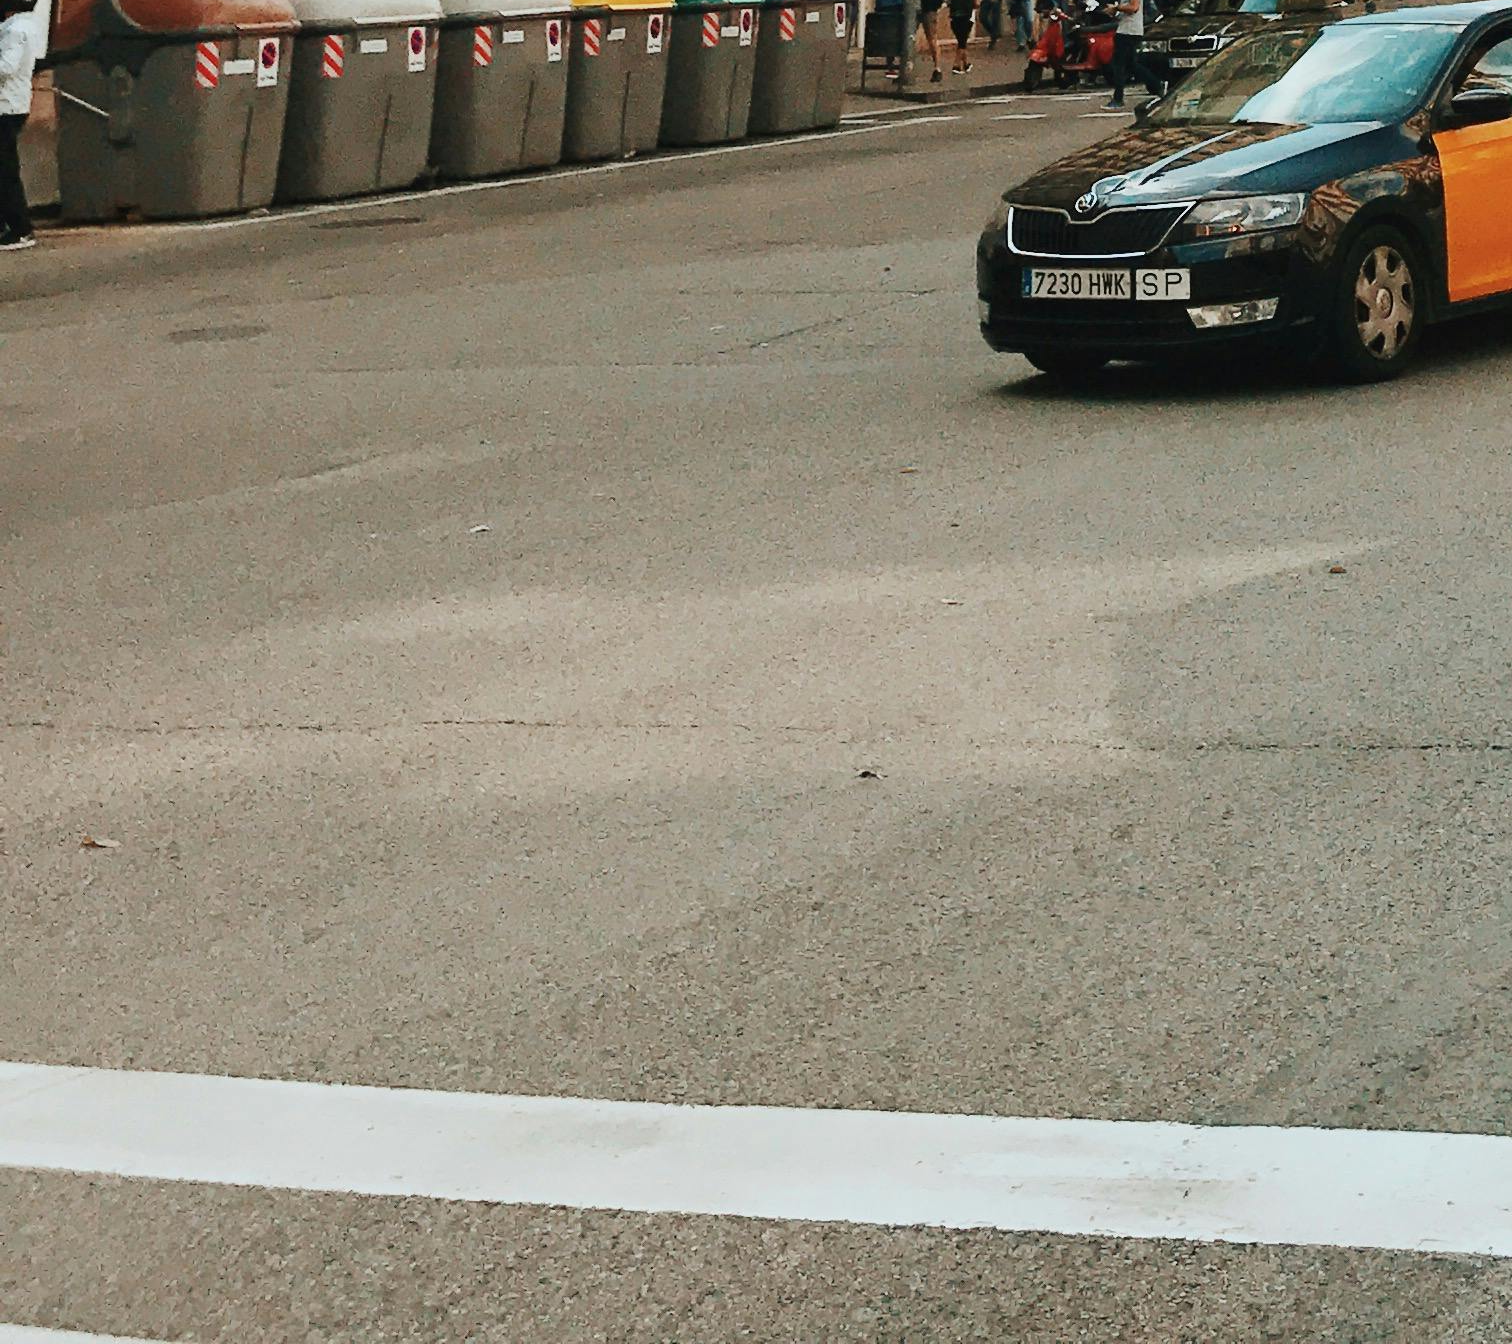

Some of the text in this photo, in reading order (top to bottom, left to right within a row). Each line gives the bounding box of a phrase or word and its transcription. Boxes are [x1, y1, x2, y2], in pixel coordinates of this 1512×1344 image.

[1034, 271, 1126, 296] 7230 HWK
[1142, 272, 1183, 297] SP
